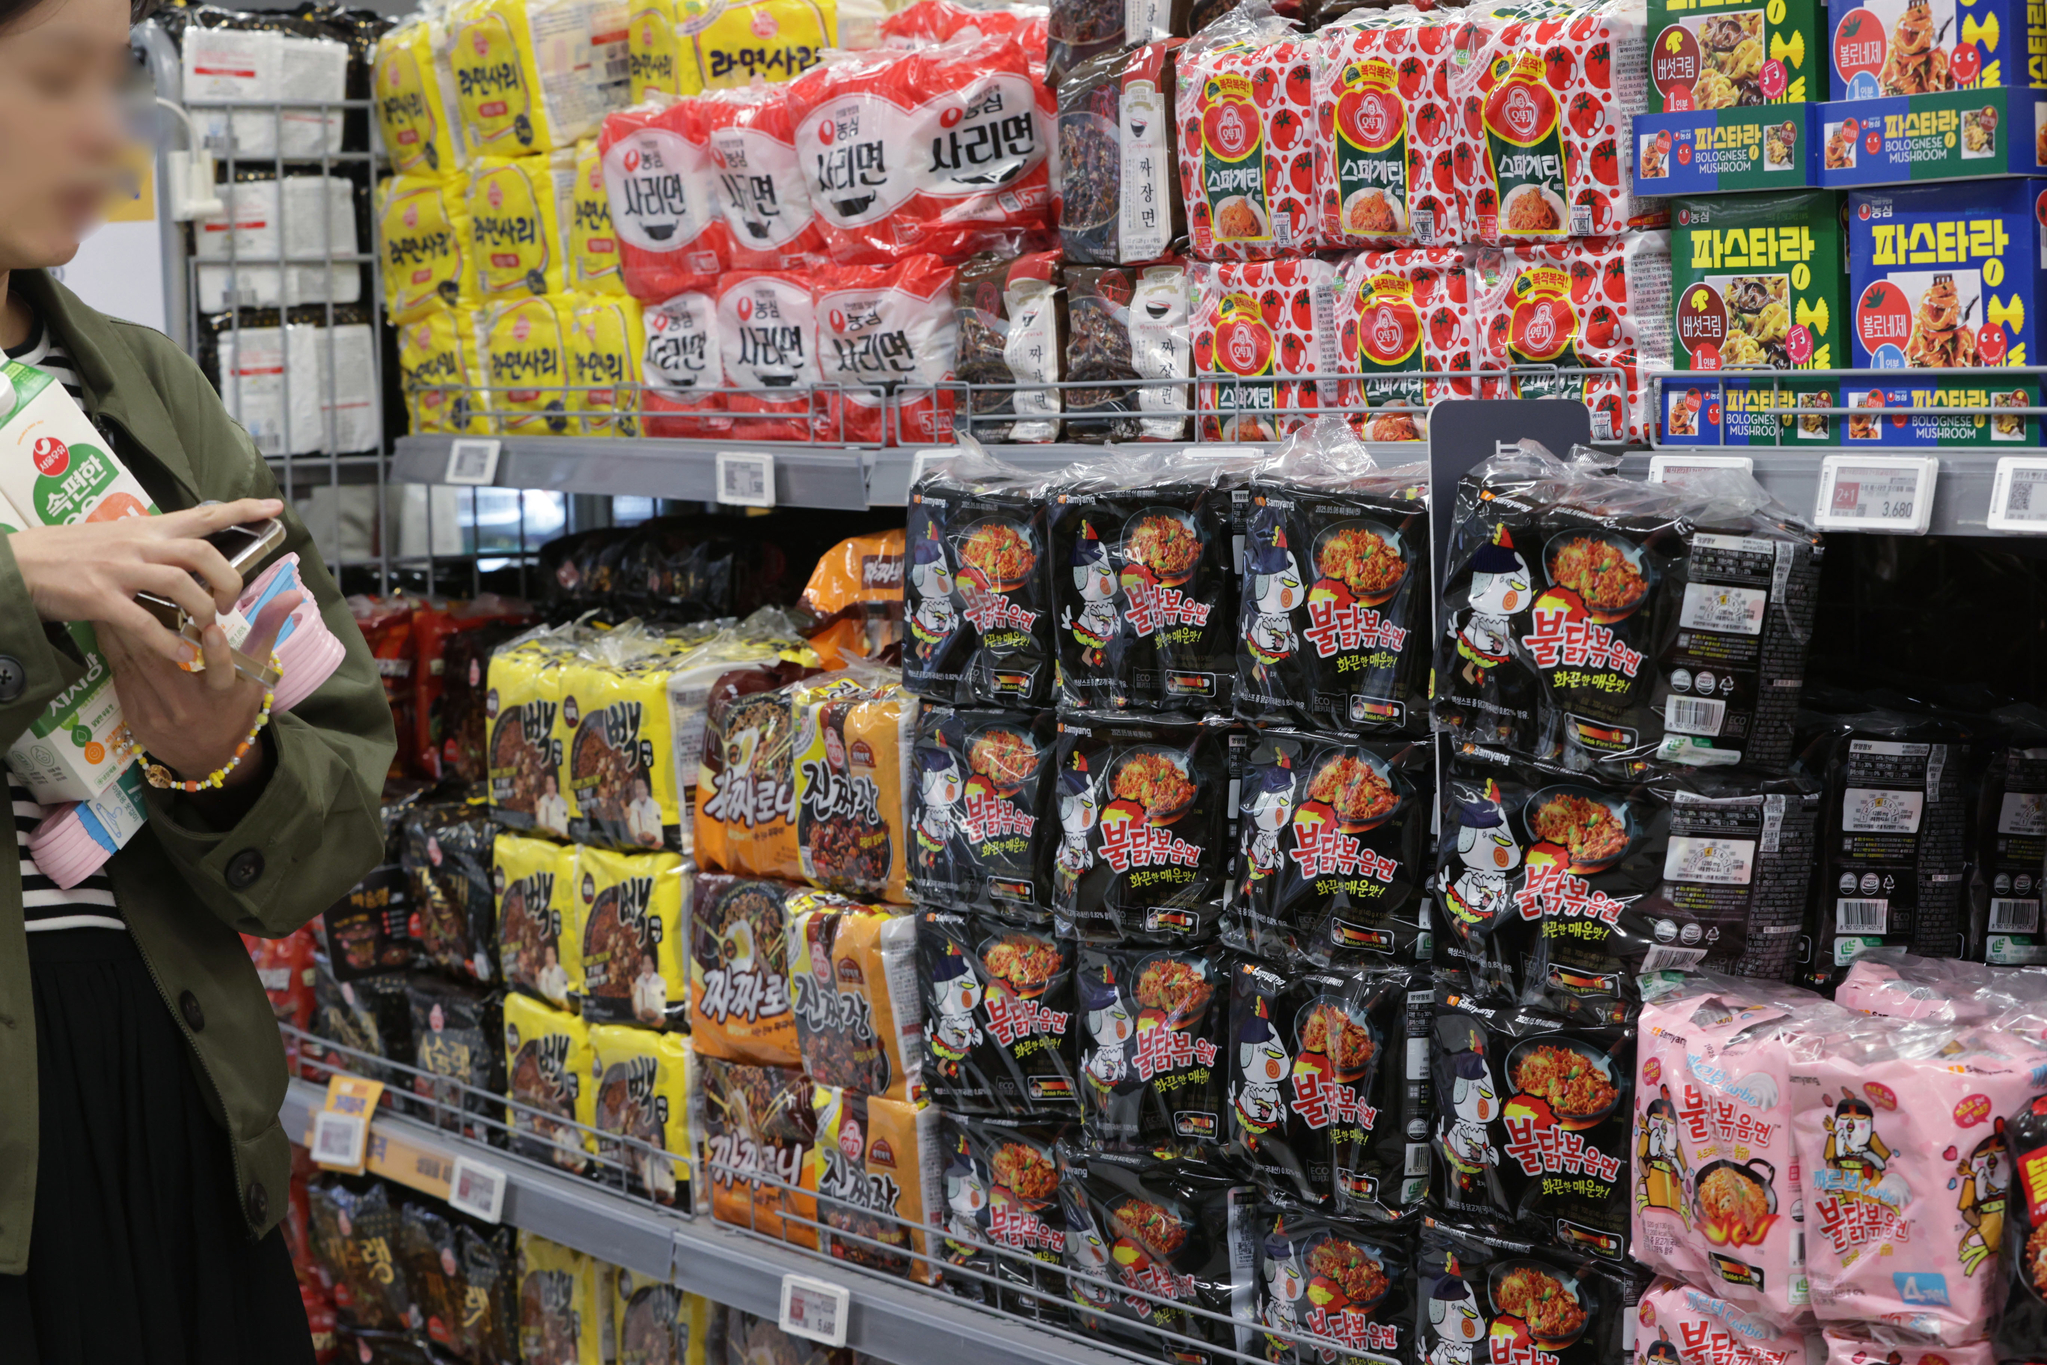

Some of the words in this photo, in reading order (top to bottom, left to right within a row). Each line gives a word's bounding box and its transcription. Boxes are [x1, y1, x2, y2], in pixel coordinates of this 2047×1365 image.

[709, 46, 822, 78] 라면사리
[1839, 40, 1882, 68] 볼로네제
[1360, 62, 1397, 83] 복작복작!
[1657, 55, 1695, 81] 버섯크림
[1852, 78, 1875, 100] 1인분
[1668, 91, 1689, 112] 1인분
[1360, 111, 1383, 130] 오뚜기
[1512, 109, 1535, 125] 오뚜기
[1884, 109, 1960, 139] 파스타랑
[928, 111, 1035, 173] 사리면
[1221, 129, 1242, 146] 오뚜기
[1694, 123, 1762, 151] 파스타랑
[1885, 136, 1943, 153] BOLOGNESE
[817, 140, 888, 192] 사리면
[1498, 153, 1563, 180] 스파게티
[1695, 149, 1748, 163] BOLOGNESE
[1889, 149, 1948, 164] MUSHROOM
[1341, 157, 1405, 185] 스파게티
[1699, 161, 1751, 174] MUSHROOM
[1207, 166, 1262, 193] 스파게티
[624, 173, 686, 216] 사리면
[1138, 157, 1156, 229] 짜장면
[574, 199, 613, 231] 라면사
[1690, 208, 1711, 224] 농심
[1871, 204, 1894, 219] 농심
[473, 216, 535, 247] 라면사리
[1871, 218, 2010, 266] 파스타랑
[1690, 225, 1816, 269] 파스타랑
[1373, 278, 1410, 294] 복작복작!
[1532, 272, 1569, 289] 복작복작!
[1376, 327, 1399, 344] 오뚜기
[1529, 325, 1550, 339] 오뚜기
[1682, 313, 1722, 339] 버섯크림
[1863, 313, 1908, 340] 볼로네제
[737, 325, 804, 369] 사리면
[833, 330, 915, 373] 사리면
[1695, 349, 1717, 371] 1인분
[1725, 413, 1776, 426] BOLOGNES
[1911, 414, 1972, 428] BOLOGNESE
[1915, 427, 1976, 440] MUSHROOM
[39, 444, 67, 472] 서울우유
[45, 453, 108, 518] 속편한
[1836, 487, 1857, 503] 2+1
[1265, 497, 1295, 512] Samyang
[1881, 501, 1914, 518] 3,680
[1124, 582, 1210, 638] 불닭볶음면
[1172, 631, 1203, 644] 매운맛!
[1302, 599, 1407, 659] 불닭볶음면
[1521, 606, 1644, 677] 불닭볶음면
[1336, 654, 1369, 673] 화끈한
[1369, 651, 1398, 669] 매운맛!
[1553, 671, 1590, 690] 화끈한
[1591, 672, 1631, 693] 매운맛!
[1313, 696, 1331, 706] ECO
[1728, 715, 1747, 725] ECO
[1063, 725, 1092, 738] Samyang
[1474, 747, 1511, 764] Samyang
[801, 757, 879, 826] 진짜장
[1098, 816, 1202, 875] 불닭볶음면
[1289, 820, 1399, 883] 불닭볶음면
[1129, 870, 1159, 889] 화끈한
[1159, 867, 1197, 885] 매운맛!
[1345, 880, 1386, 899] 매운맛!
[1513, 863, 1626, 924] 불닭볶음면
[1567, 920, 1609, 942] 매운맛!
[794, 971, 871, 1040] 진짜장
[1457, 999, 1496, 1019] Samyang
[1659, 1029, 1688, 1049] Samyang
[1131, 1026, 1218, 1083] 불닭볶음면
[1154, 1074, 1188, 1095] 화끈한
[1503, 1114, 1622, 1183] 불닭볶음면
[1310, 1165, 1330, 1176] ECO
[1813, 1169, 1859, 1190] 까르보
[1542, 1179, 1573, 1196] 화끈한
[1572, 1178, 1611, 1200] 매운맛!
[1815, 1194, 1912, 1254] 불닭볶음면
[1724, 1309, 1765, 1341] Carbo
